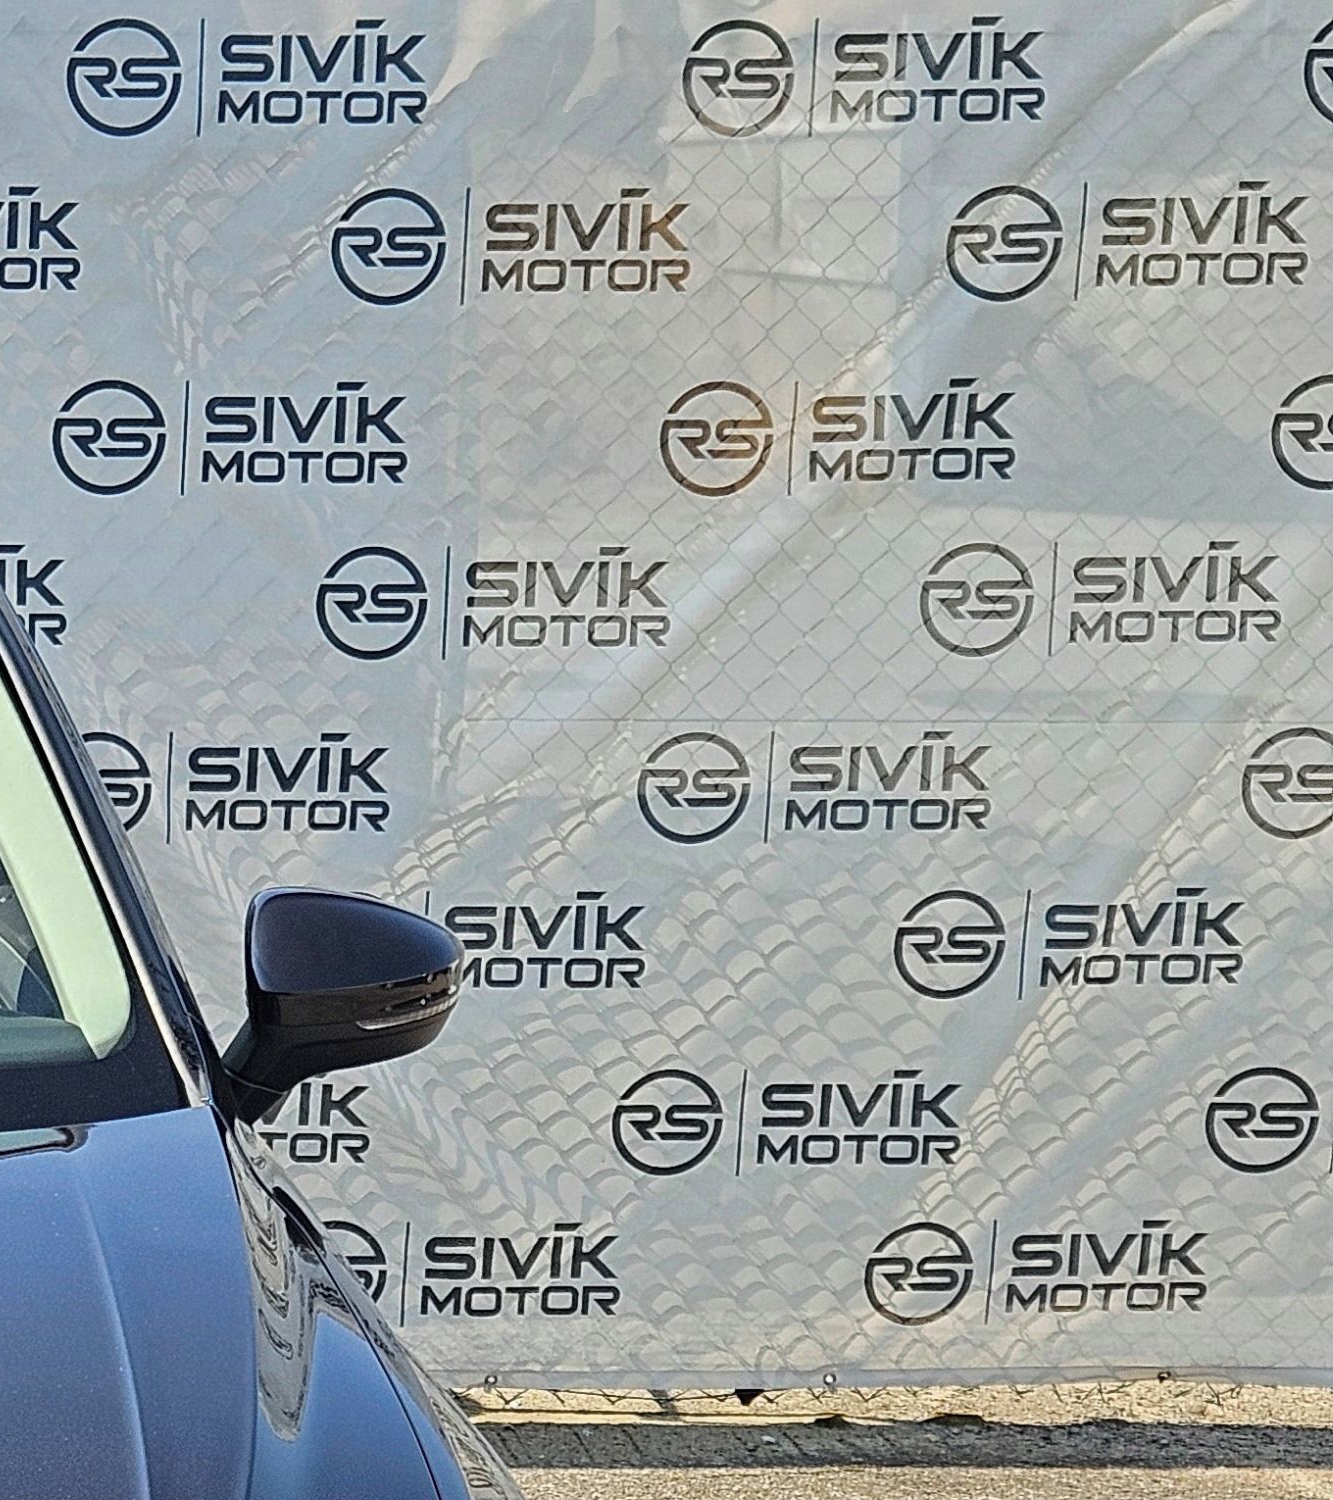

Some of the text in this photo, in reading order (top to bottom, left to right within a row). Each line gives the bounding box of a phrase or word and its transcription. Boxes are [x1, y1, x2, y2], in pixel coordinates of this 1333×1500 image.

[218, 90, 427, 124] MOTOR
[832, 91, 1045, 122] MOTOR
[482, 259, 689, 291] MOTOR
[1096, 256, 1307, 286] MOTOR
[202, 451, 407, 483] MOTOR
[810, 452, 1015, 481] MOTOR
[463, 616, 670, 647] MOTOR
[1069, 613, 1281, 643] MOTOR
[186, 800, 389, 831] MOTOR
[785, 800, 989, 830] MOTOR
[1040, 956, 1242, 987] MOTOR
[757, 1134, 960, 1164] MOTOR
[421, 1286, 620, 1316] MOTOR
[1006, 1285, 1206, 1312] MOTOR
